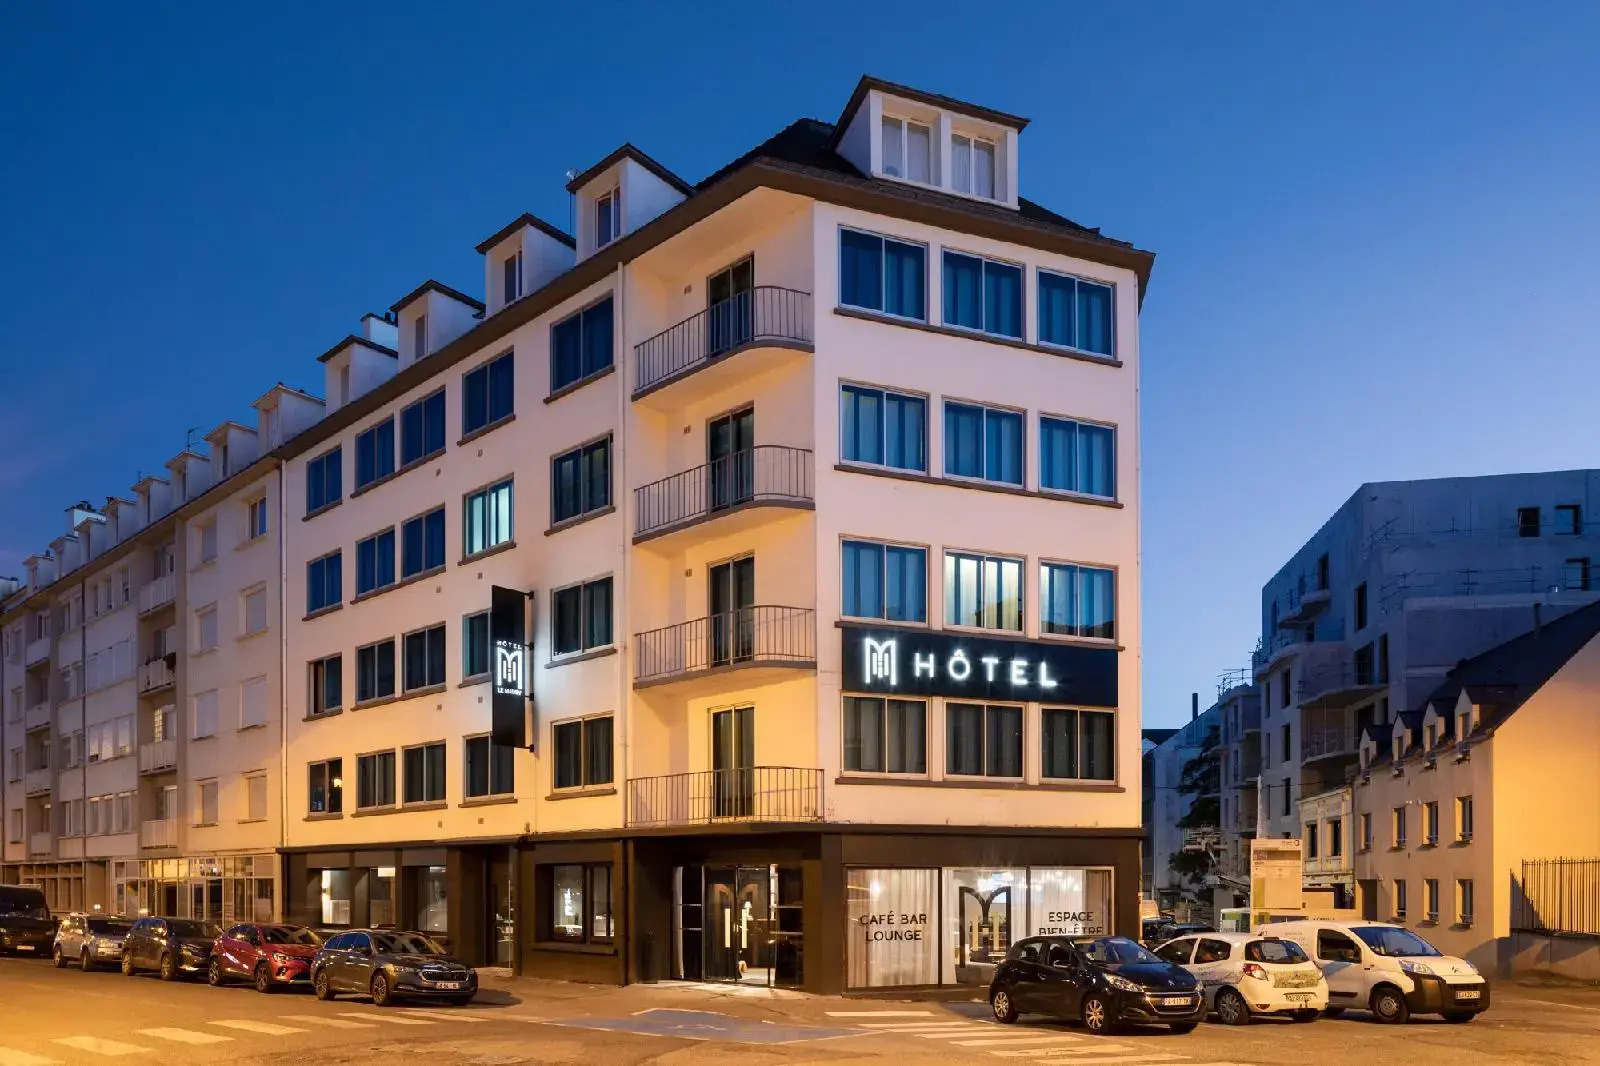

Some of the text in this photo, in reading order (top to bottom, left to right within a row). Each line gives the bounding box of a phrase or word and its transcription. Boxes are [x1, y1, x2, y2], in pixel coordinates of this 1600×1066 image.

[914, 649, 1057, 687] HÔTEL
[860, 910, 927, 925] CAFÉ BAR
[1048, 911, 1094, 922] ESPACE
[865, 930, 922, 942] LOUNGE
